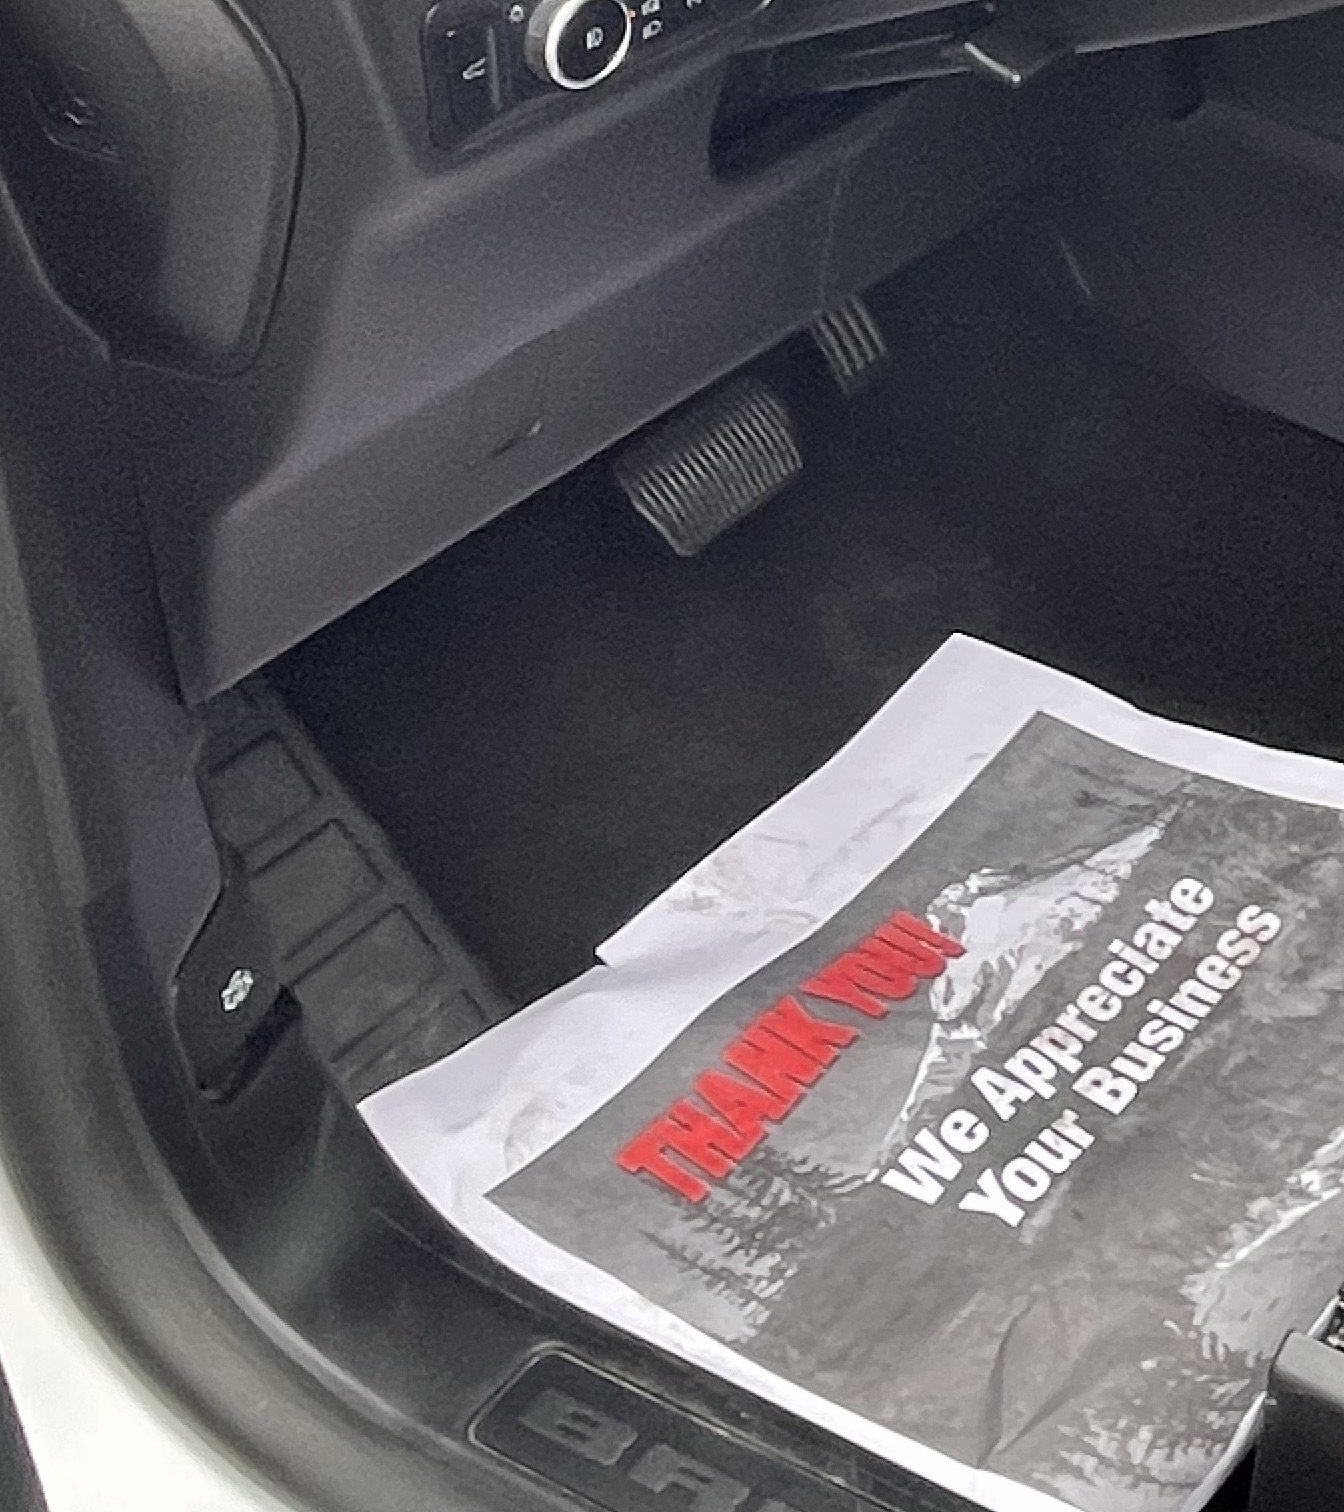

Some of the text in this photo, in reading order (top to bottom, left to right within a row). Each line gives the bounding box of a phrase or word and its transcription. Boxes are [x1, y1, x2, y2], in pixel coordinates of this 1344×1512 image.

[614, 910, 967, 1204] THANK YOU!
[881, 875, 1214, 1207] We Appreciate
[958, 903, 1282, 1228] Your Business
